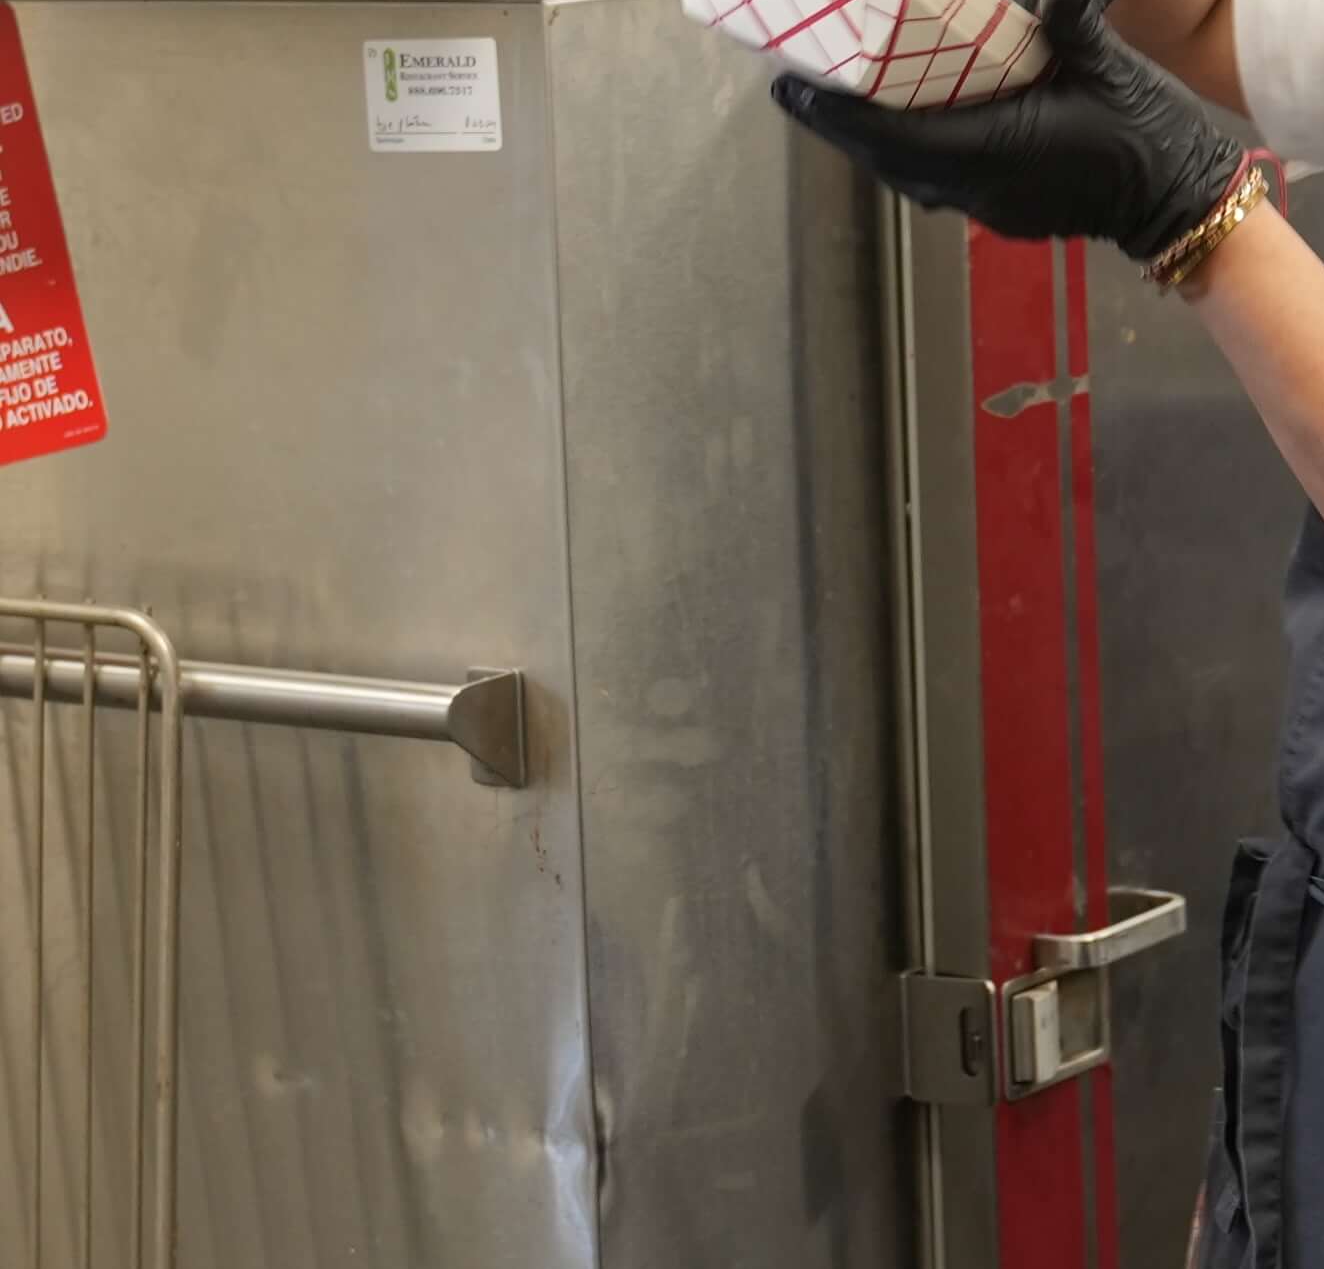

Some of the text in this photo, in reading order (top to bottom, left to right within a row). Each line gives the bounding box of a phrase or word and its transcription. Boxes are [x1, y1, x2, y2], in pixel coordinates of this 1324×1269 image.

[400, 53, 476, 68] EMERALD
[33, 374, 59, 398] DE
[6, 390, 93, 429] ACTIVADO.
